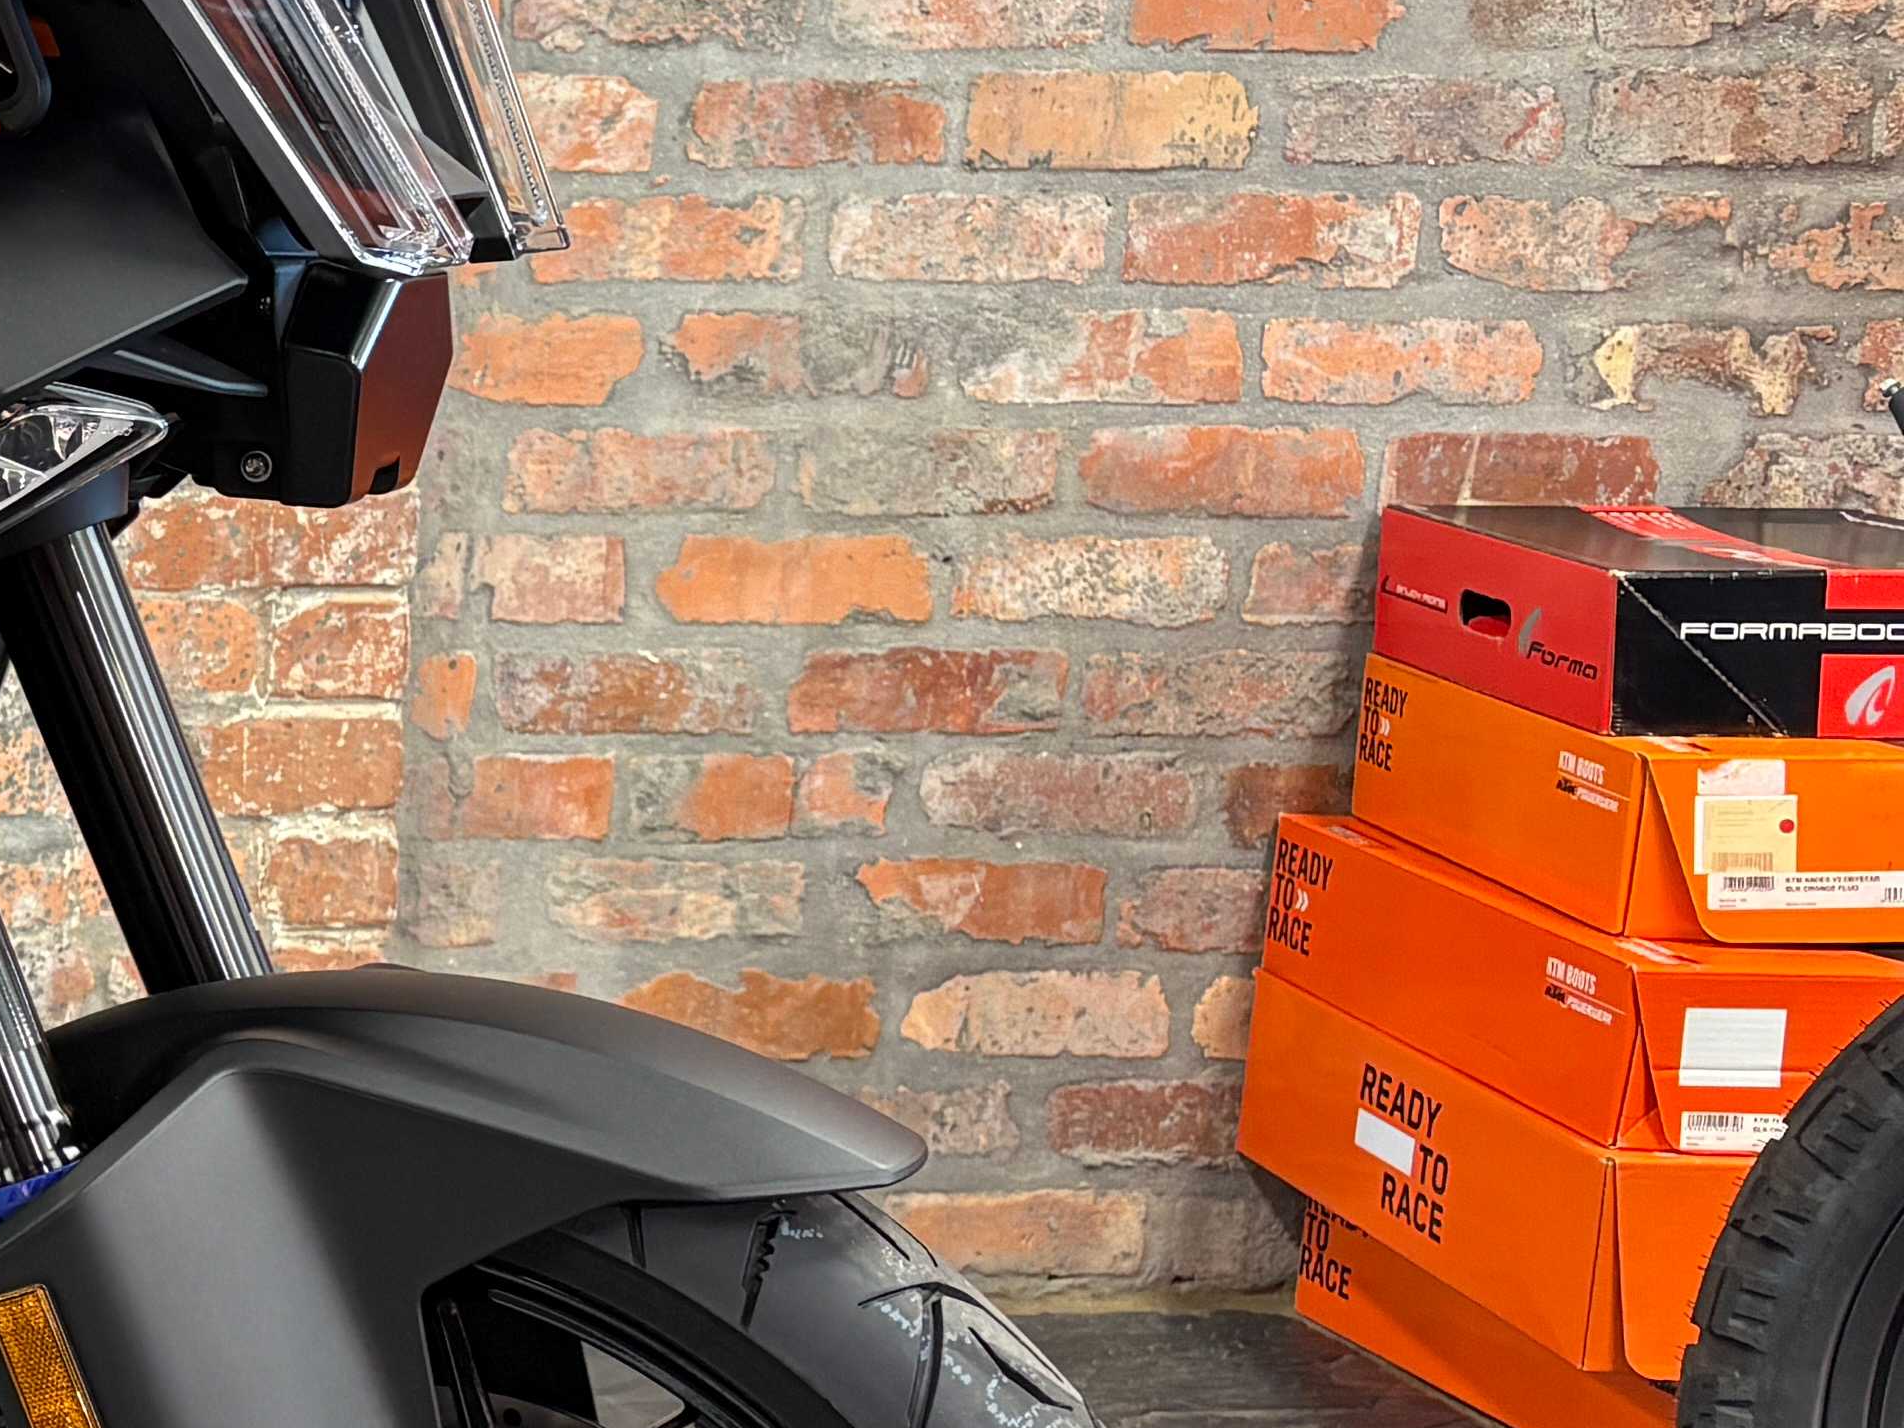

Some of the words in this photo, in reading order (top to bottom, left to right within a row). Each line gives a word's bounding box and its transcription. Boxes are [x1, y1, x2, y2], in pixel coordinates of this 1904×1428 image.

[1527, 641, 1598, 680] Forma
[1364, 677, 1408, 718] READY
[1363, 706, 1379, 736] TO
[1359, 735, 1392, 772] RACE
[1276, 838, 1333, 891] READY
[1275, 872, 1294, 911] TO
[1268, 906, 1312, 956] RACE
[1566, 964, 1597, 995] BOOTS
[1360, 1063, 1442, 1139] READY
[1419, 1145, 1449, 1196] TO
[1381, 1172, 1443, 1244] RACE
[1306, 1211, 1330, 1252] TO
[1299, 1243, 1352, 1300] RACE
